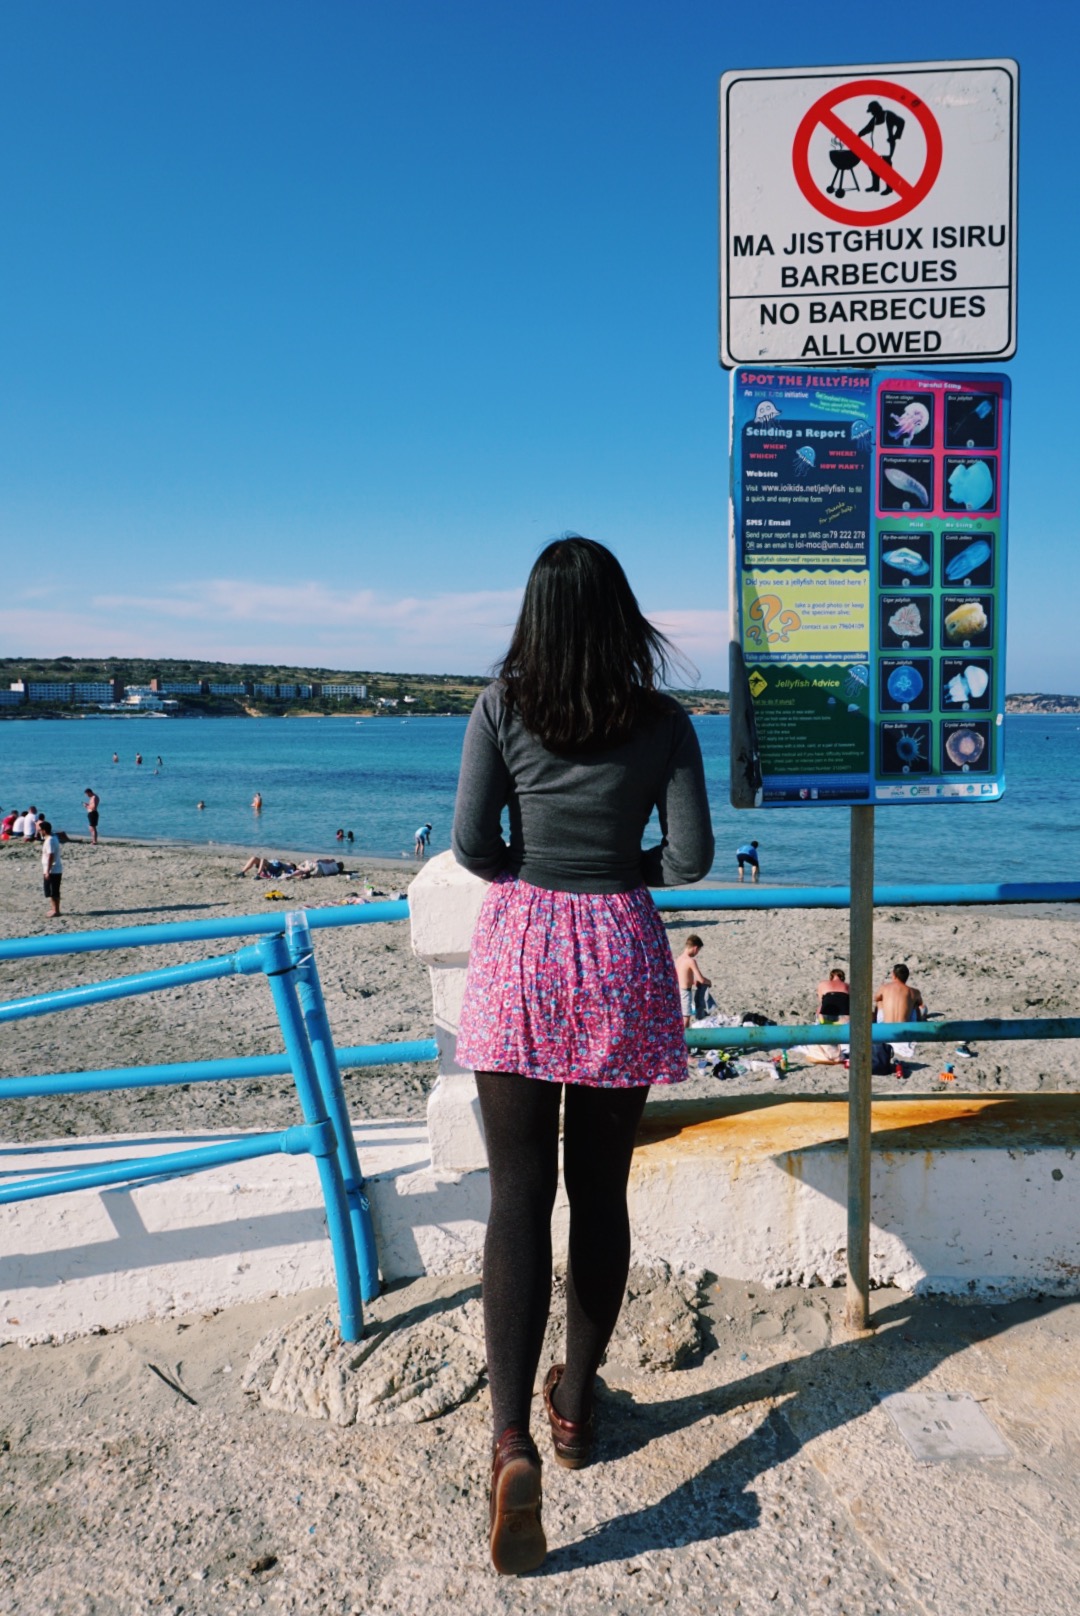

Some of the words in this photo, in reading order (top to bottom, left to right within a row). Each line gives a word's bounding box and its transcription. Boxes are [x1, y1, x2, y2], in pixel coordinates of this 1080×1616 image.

[733, 234, 774, 257] MA
[932, 224, 1006, 248] ISIRU
[781, 260, 958, 288] BARBECUES
[760, 302, 800, 324] NO
[809, 296, 986, 324] BARBECUES
[800, 330, 942, 356] ALLOWED
[778, 376, 802, 385] THE
[746, 427, 792, 438] Sending
[806, 429, 845, 439] Report
[762, 484, 845, 494] www.ioikids.net/jellyfish
[795, 541, 864, 550] ioi-moc@um.edu.mt
[775, 680, 810, 689] Jellyfish
